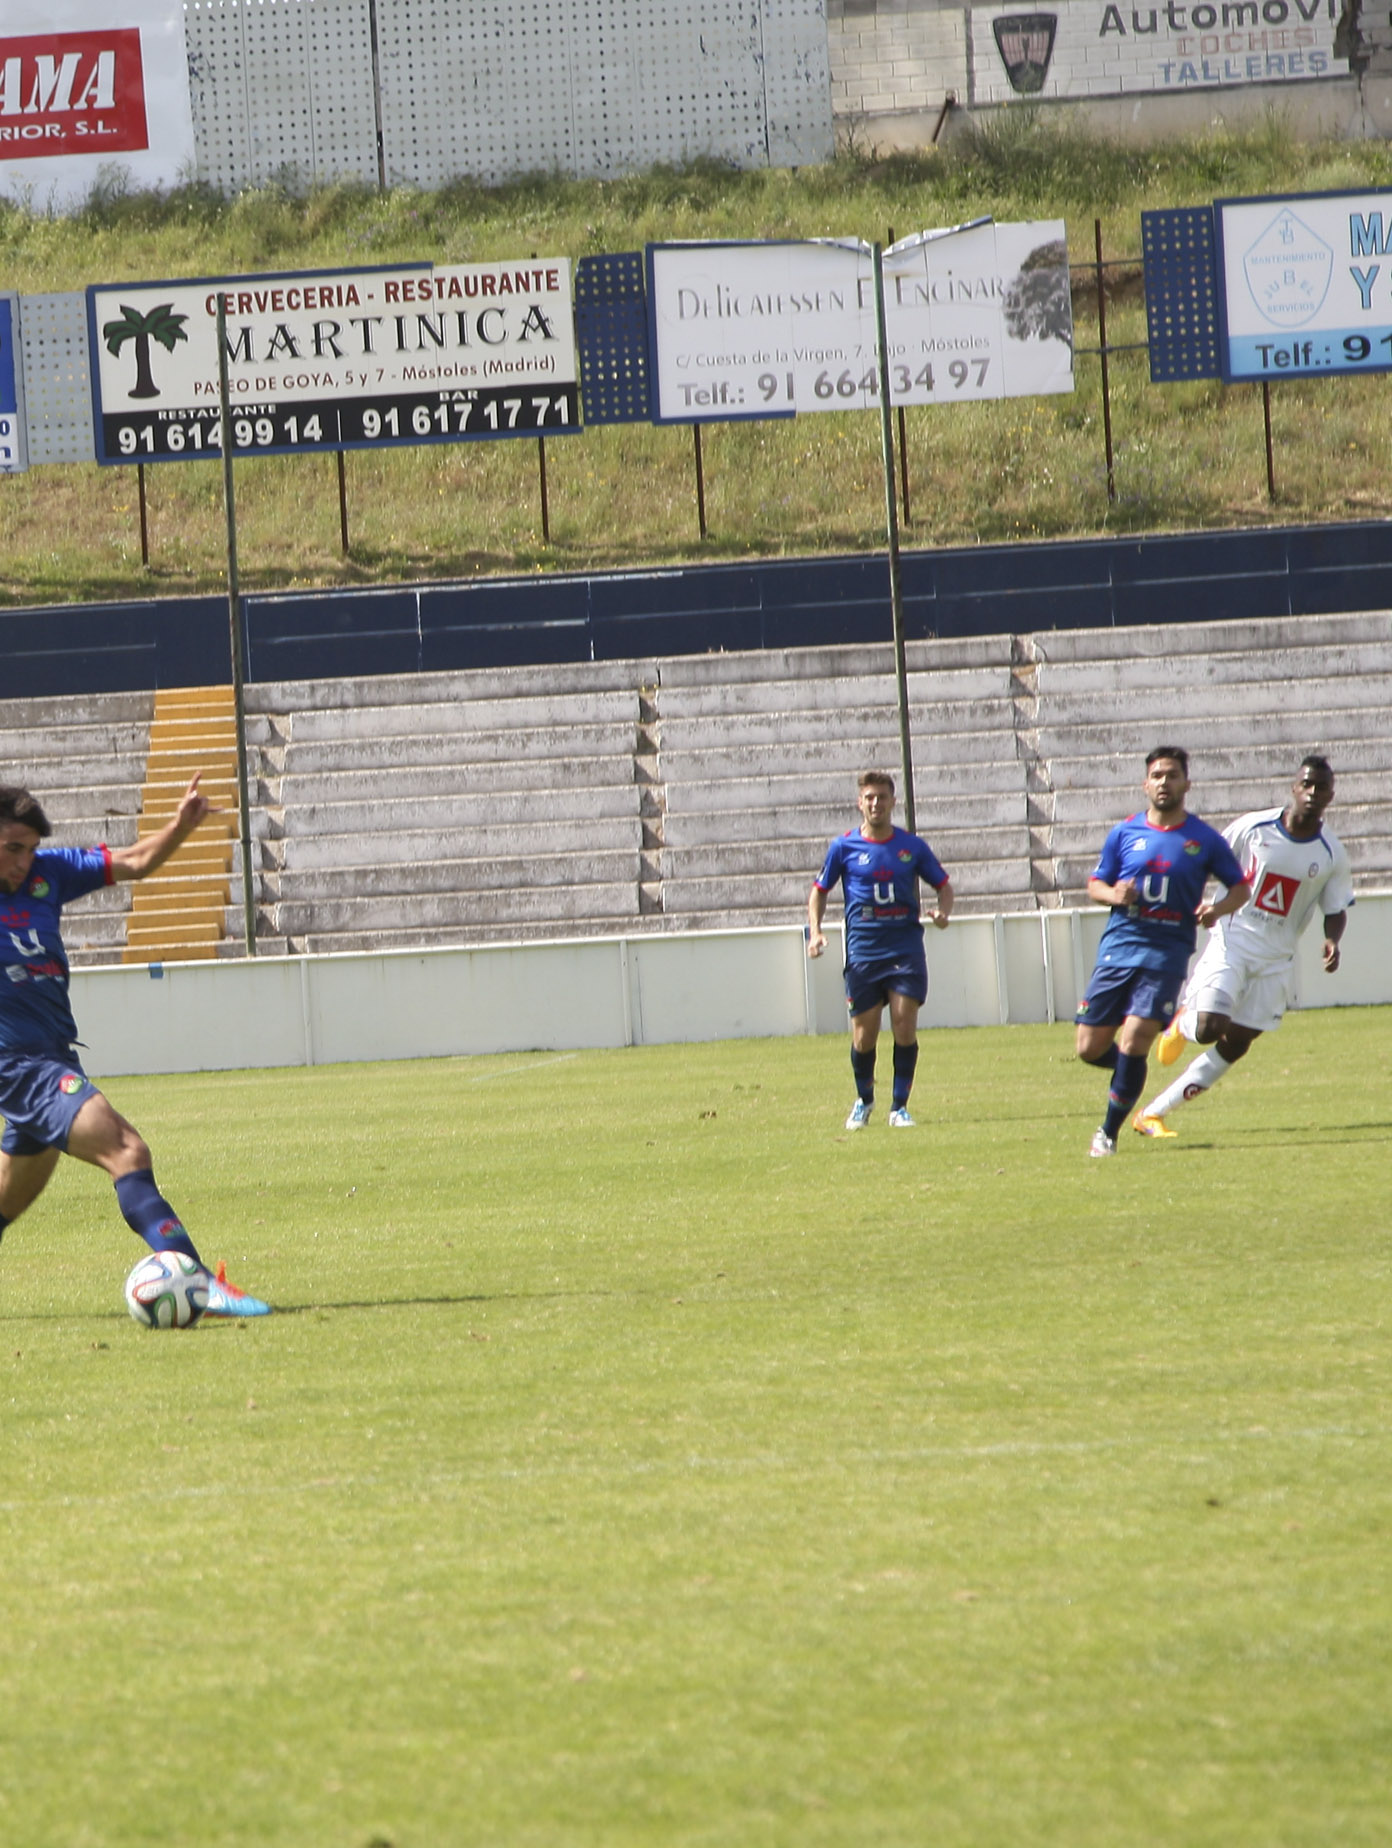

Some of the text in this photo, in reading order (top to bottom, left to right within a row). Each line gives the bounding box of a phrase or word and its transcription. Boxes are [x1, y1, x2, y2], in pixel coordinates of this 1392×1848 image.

[1177, 28, 1314, 57] COCHES
[1158, 51, 1328, 84] TALLERES
[75, 120, 119, 136] S.L.
[1251, 252, 1326, 266] MANTENIMIENTO
[205, 283, 360, 317] CERVECERIA
[384, 268, 560, 304] RESTAURANTE
[1349, 265, 1381, 310] Y
[1267, 303, 1316, 314] SERVICIOS
[216, 303, 558, 365] MARTINICA
[676, 354, 691, 369] C/
[696, 351, 747, 367] Cuesta
[752, 350, 771, 364] de
[775, 349, 789, 363] la
[793, 346, 848, 365] Virgen,
[921, 335, 990, 353] Móstoles
[1255, 340, 1331, 370] Telf.:
[256, 377, 277, 392] DE
[283, 372, 339, 390] GOYA,
[345, 370, 354, 385] 5
[359, 373, 368, 388] y
[376, 368, 384, 383] 7
[402, 361, 478, 381] Móstoles
[483, 354, 556, 378] (Madrid)
[677, 357, 991, 407] Telf.: 91 664 34 97
[439, 389, 479, 402] BAR
[158, 404, 277, 421] RESTAUANTE
[362, 395, 570, 439] 91 617 17 71
[118, 414, 323, 454] 91 614 99 14
